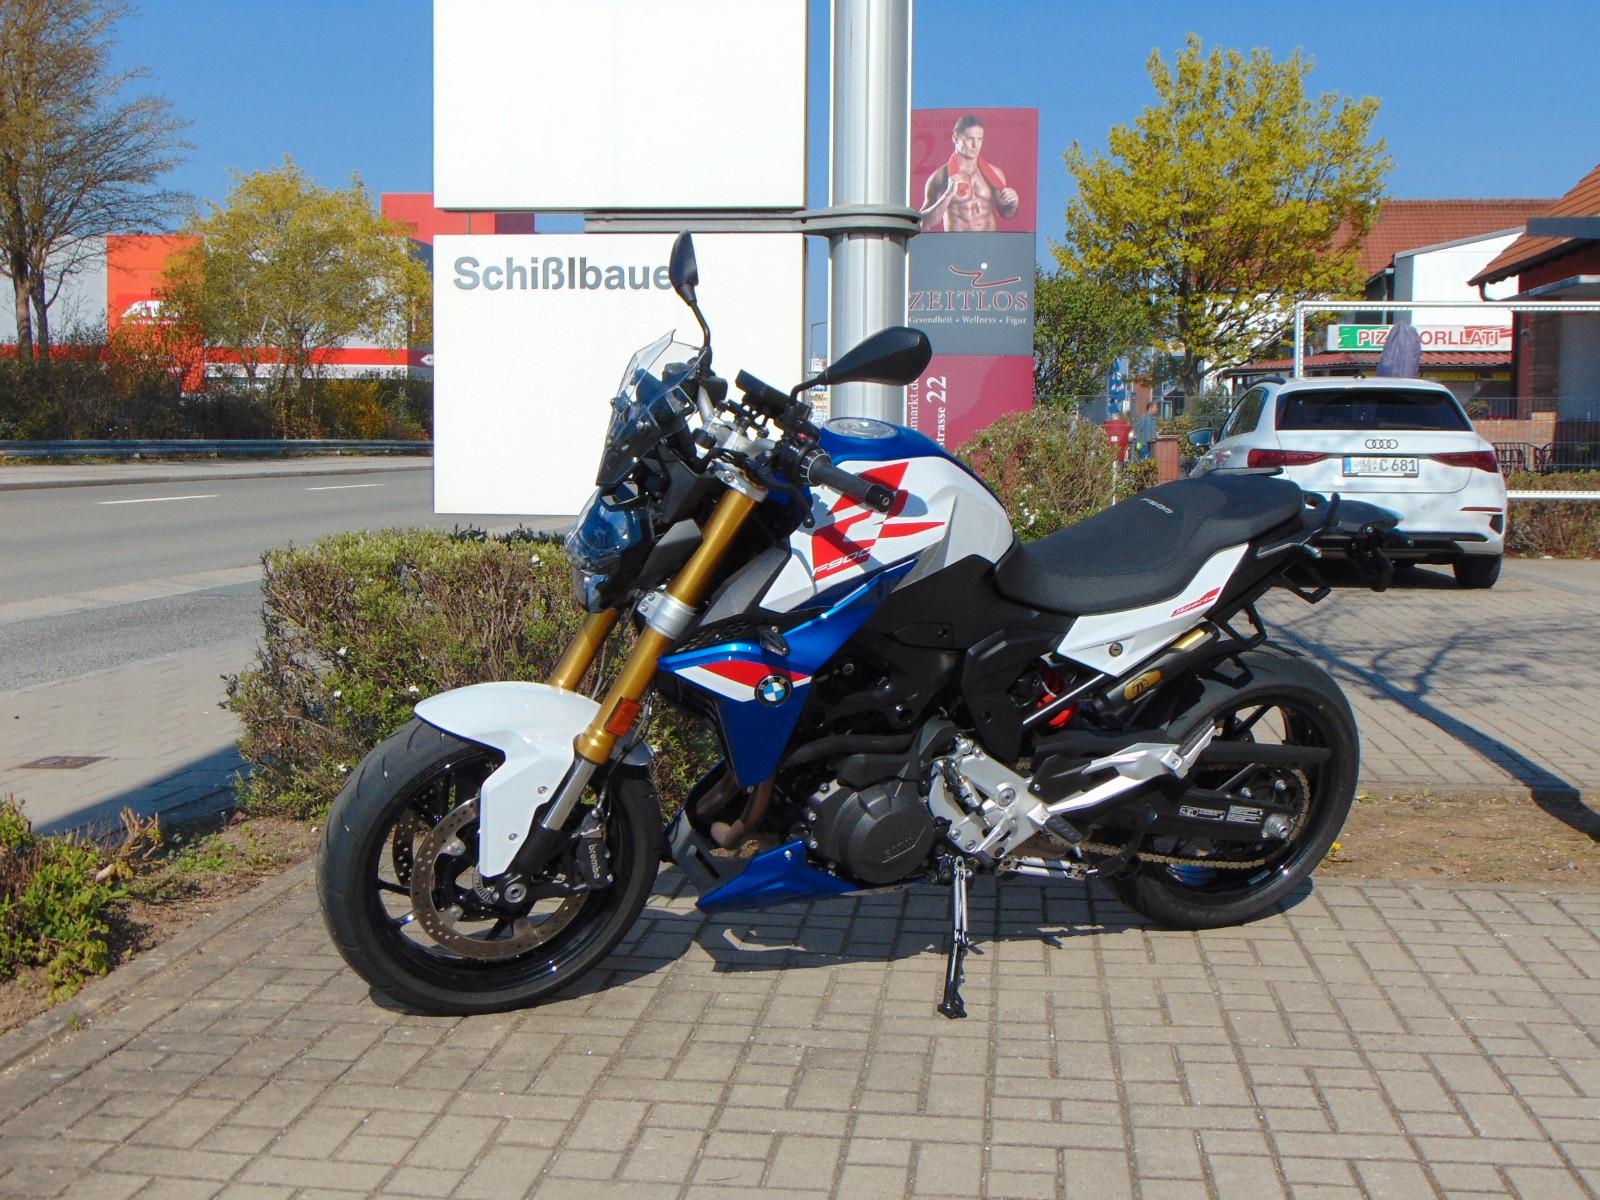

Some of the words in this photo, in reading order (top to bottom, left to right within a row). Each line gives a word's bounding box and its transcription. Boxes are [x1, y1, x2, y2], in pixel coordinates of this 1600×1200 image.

[453, 256, 672, 290] Schißlbaue
[908, 290, 1028, 311] ZEITLOS
[1358, 331, 1387, 345] PIZ
[926, 375, 946, 403] 22
[588, 843, 600, 879] brembo
